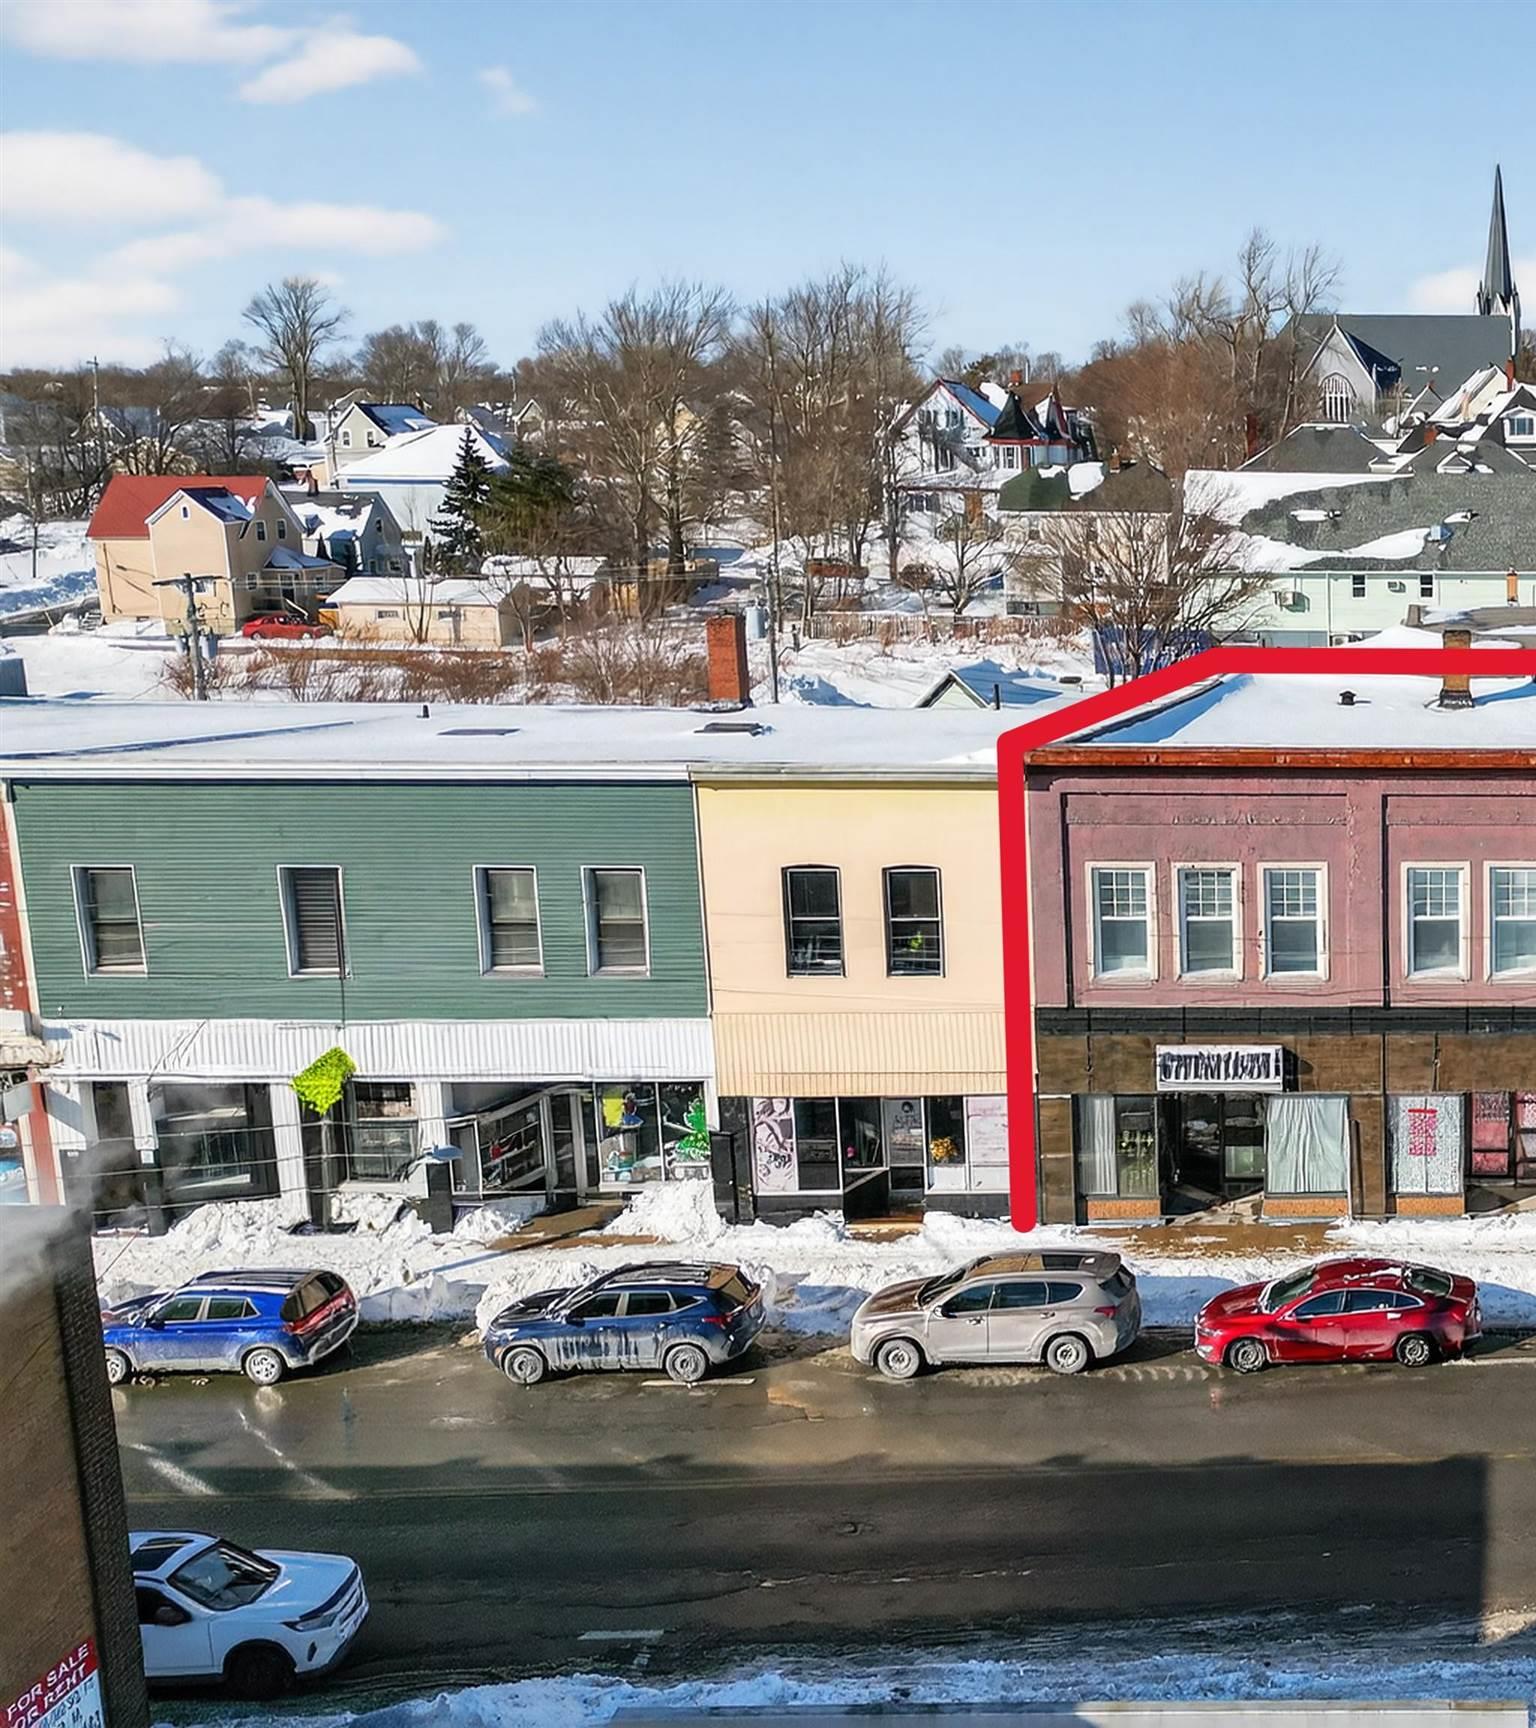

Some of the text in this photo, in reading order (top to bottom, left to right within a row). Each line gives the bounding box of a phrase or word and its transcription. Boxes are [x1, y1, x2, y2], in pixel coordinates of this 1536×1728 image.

[6, 1683, 43, 1721] FOR
[46, 1643, 90, 1687] SALE
[10, 1705, 39, 1728] OR
